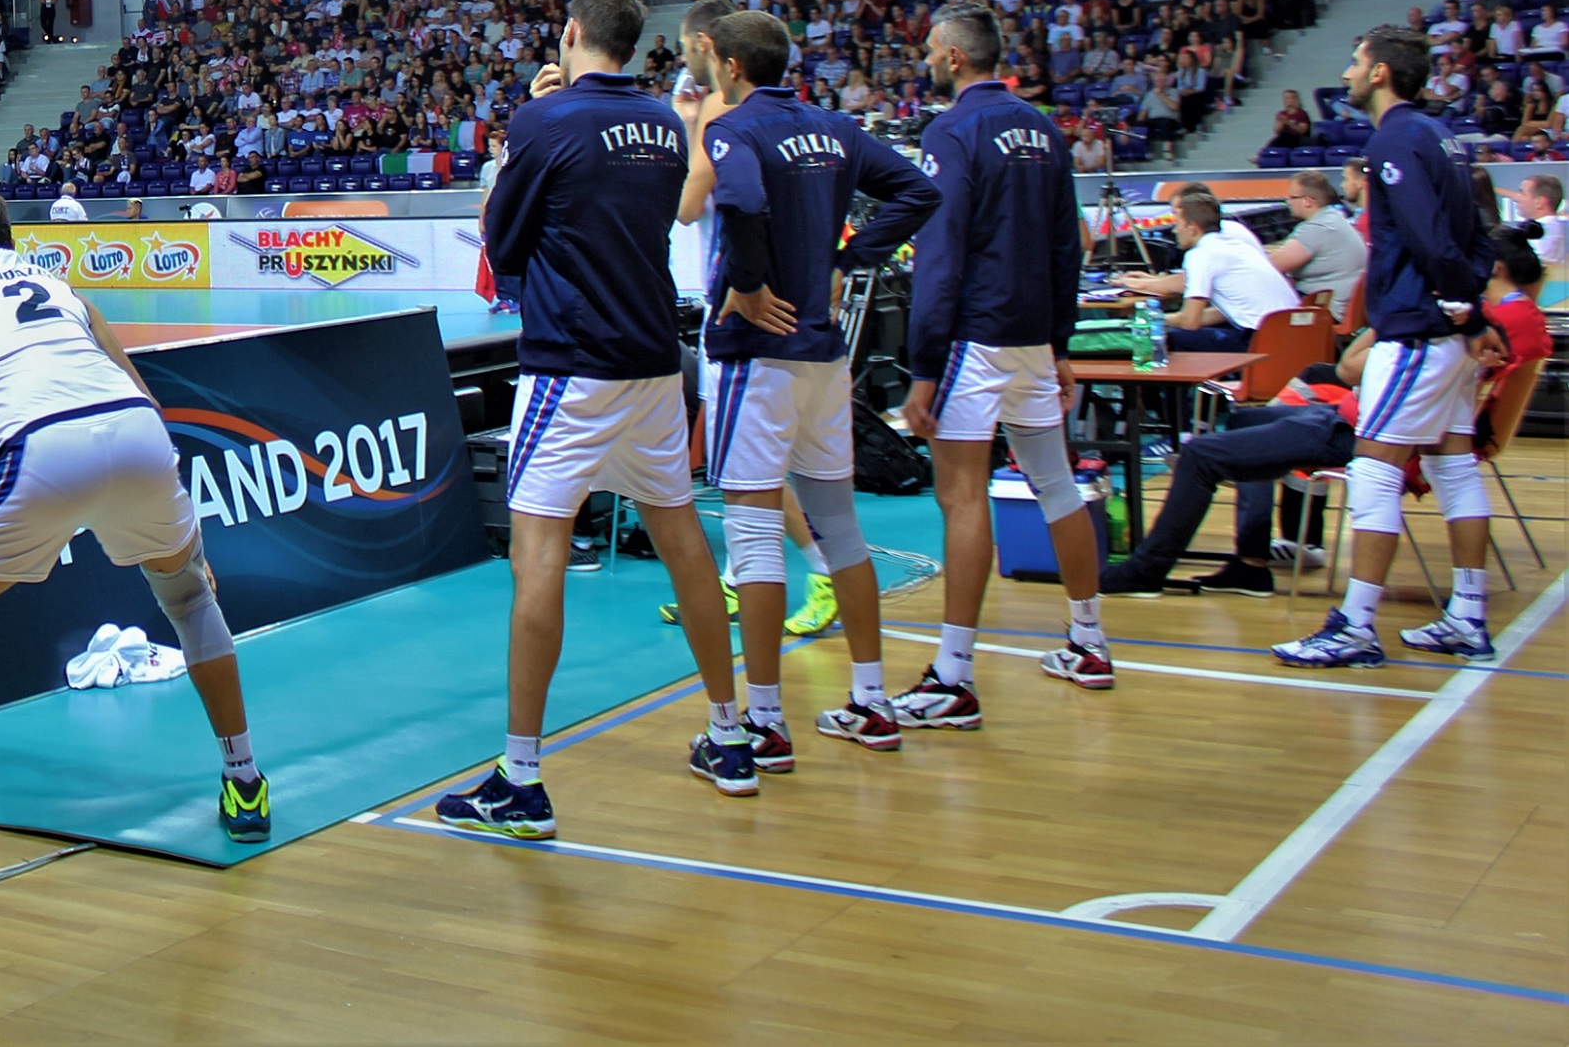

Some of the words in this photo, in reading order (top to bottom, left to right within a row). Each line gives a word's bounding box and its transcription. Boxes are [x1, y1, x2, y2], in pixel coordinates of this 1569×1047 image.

[600, 122, 680, 154] ITALIA
[776, 133, 846, 162] ITALIA
[993, 128, 1051, 154] ITALIA
[258, 231, 345, 248] BLACHY
[91, 250, 123, 271] LOTTO
[154, 249, 188, 271] LOTTO
[258, 251, 394, 279] PRUSZYŃSKI
[3, 280, 63, 324] 2
[190, 439, 308, 528] AND
[314, 412, 428, 502] 2017
